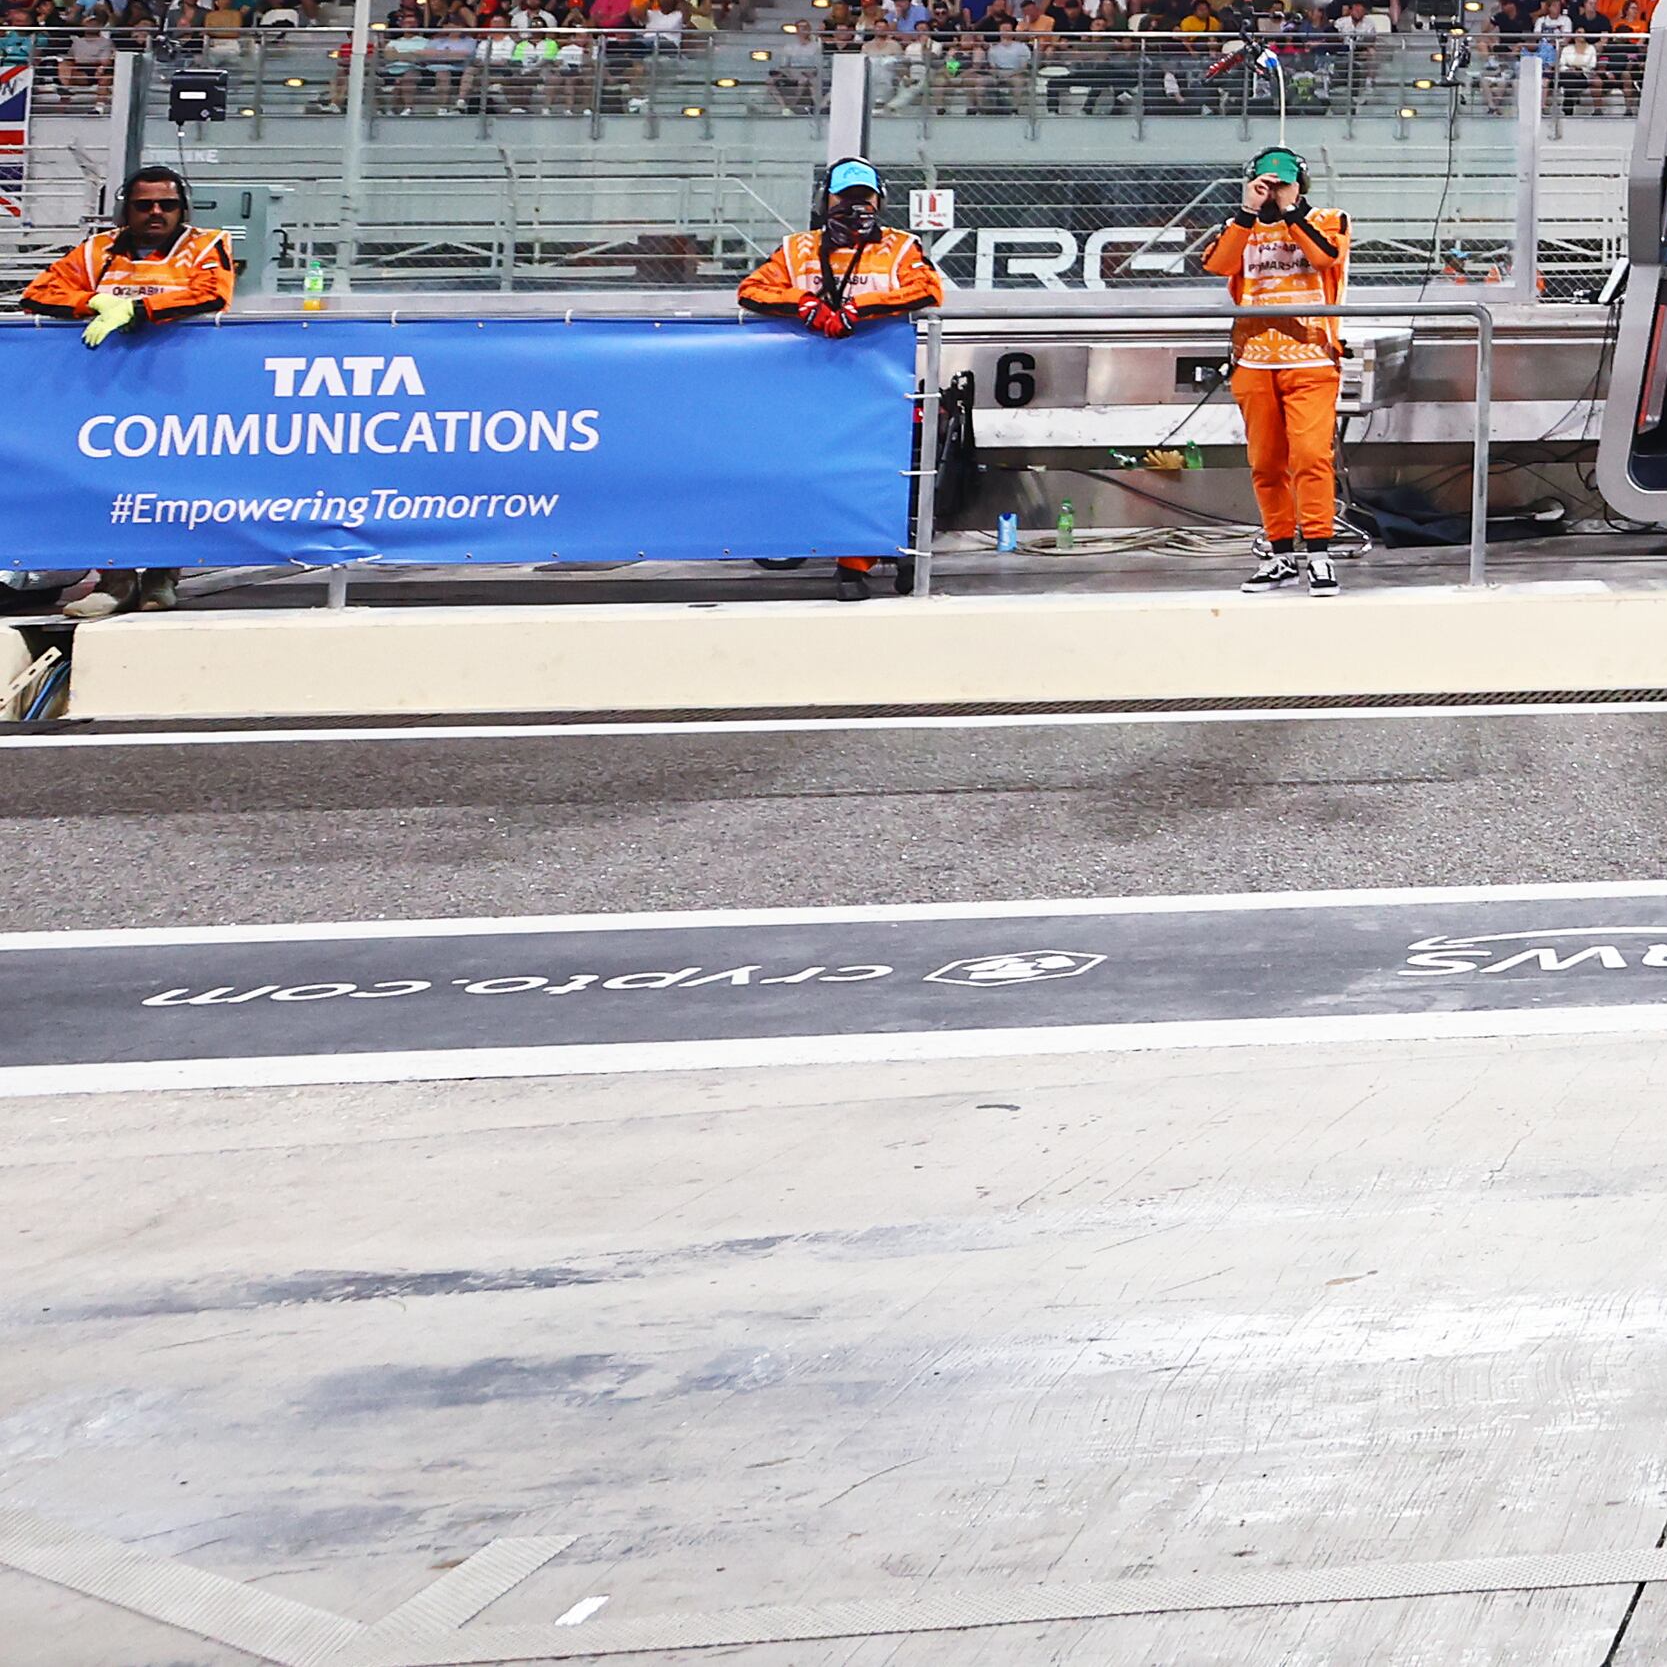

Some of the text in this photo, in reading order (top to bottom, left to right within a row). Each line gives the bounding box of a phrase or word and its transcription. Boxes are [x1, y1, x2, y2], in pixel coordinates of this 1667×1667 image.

[265, 356, 425, 397] TATA
[995, 352, 1035, 410] 6
[77, 408, 600, 460] COMMUNICATIONS
[110, 488, 559, 530] #EmpoweringTomorrow
[141, 964, 895, 1008] crypto.com
